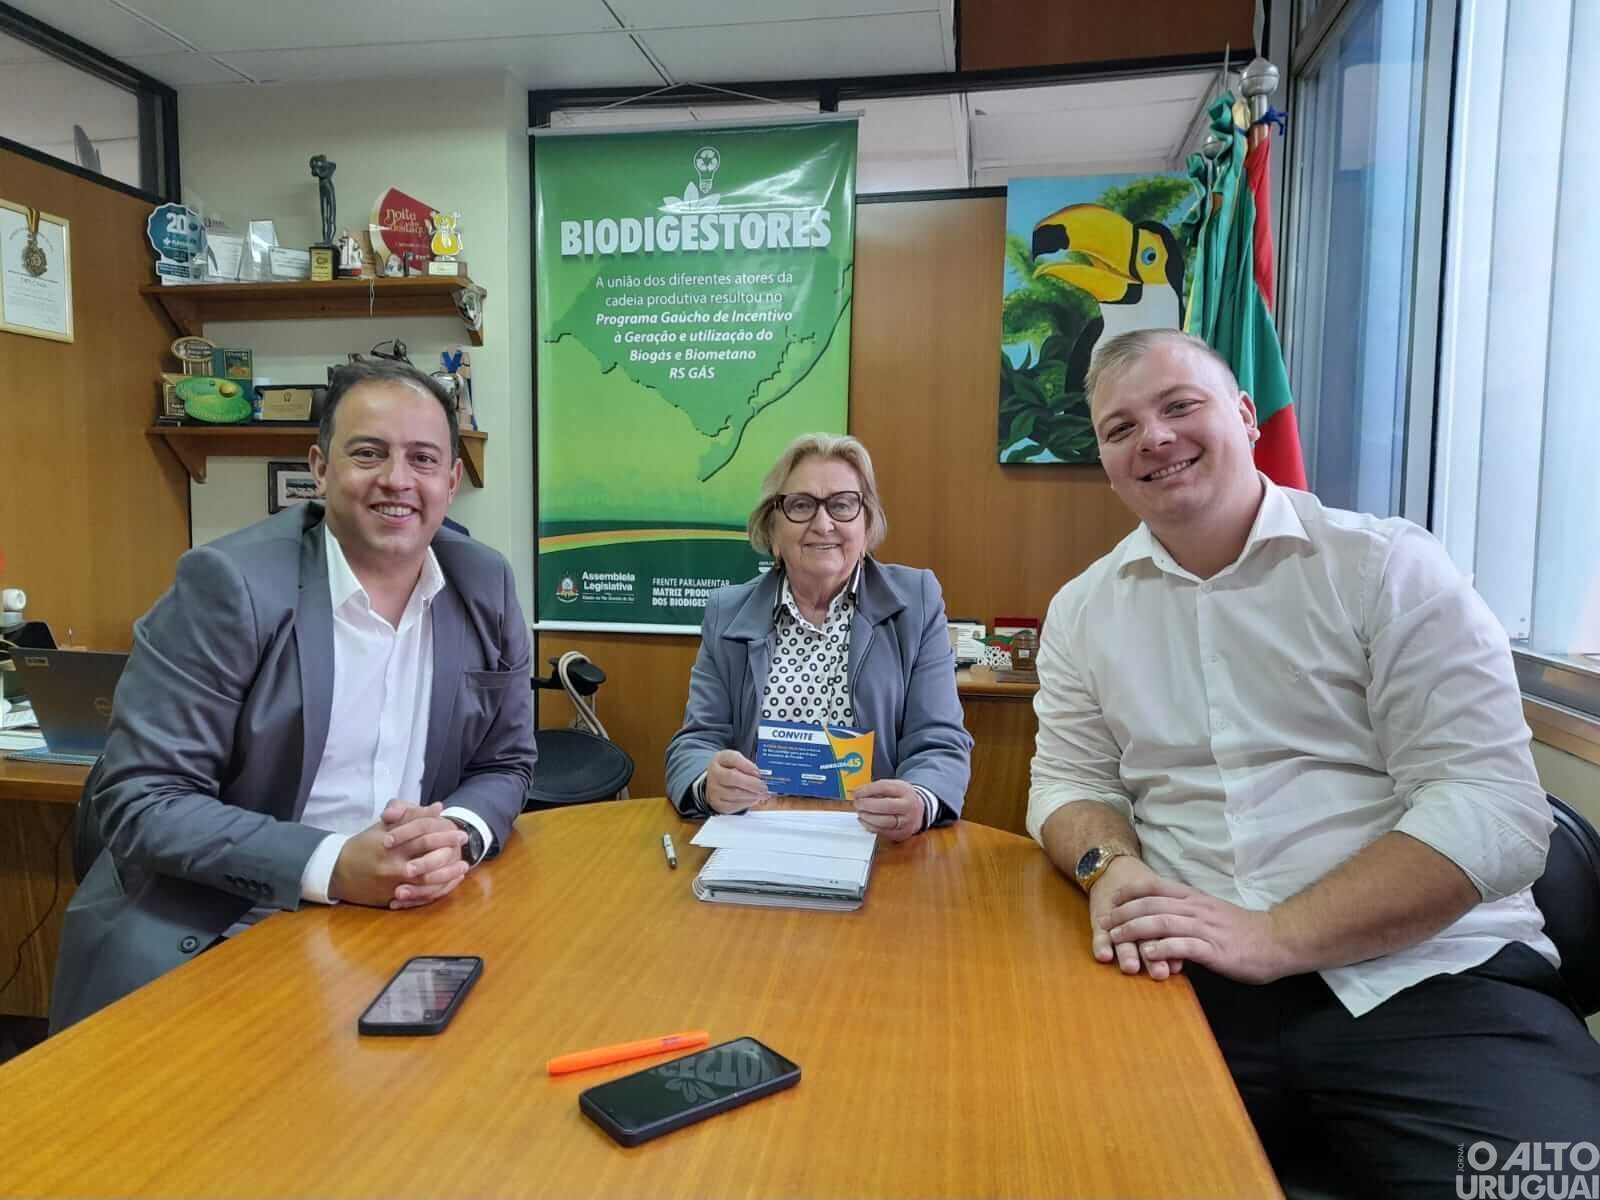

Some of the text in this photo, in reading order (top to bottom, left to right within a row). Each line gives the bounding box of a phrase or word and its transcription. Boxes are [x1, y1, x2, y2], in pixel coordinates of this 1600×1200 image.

[560, 210, 832, 256] BIODIGESTORES
[595, 271, 793, 288] A união dos diferentes atores da
[605, 292, 783, 308] cadeia produtiva resultou no
[596, 310, 793, 327] Programa Gaúcho de Incentivo
[614, 328, 774, 345] à Geração e utilização do
[629, 349, 756, 364] Biogás e Biometano
[669, 365, 715, 379] RS GÁS
[582, 571, 635, 581] Assembleia
[652, 578, 730, 587] FRENTE PARLAMENTAR
[583, 581, 633, 592] Legislativa
[652, 588, 683, 597] MATRIZ
[652, 598, 668, 607] DOS
[772, 729, 814, 741] CONVITE
